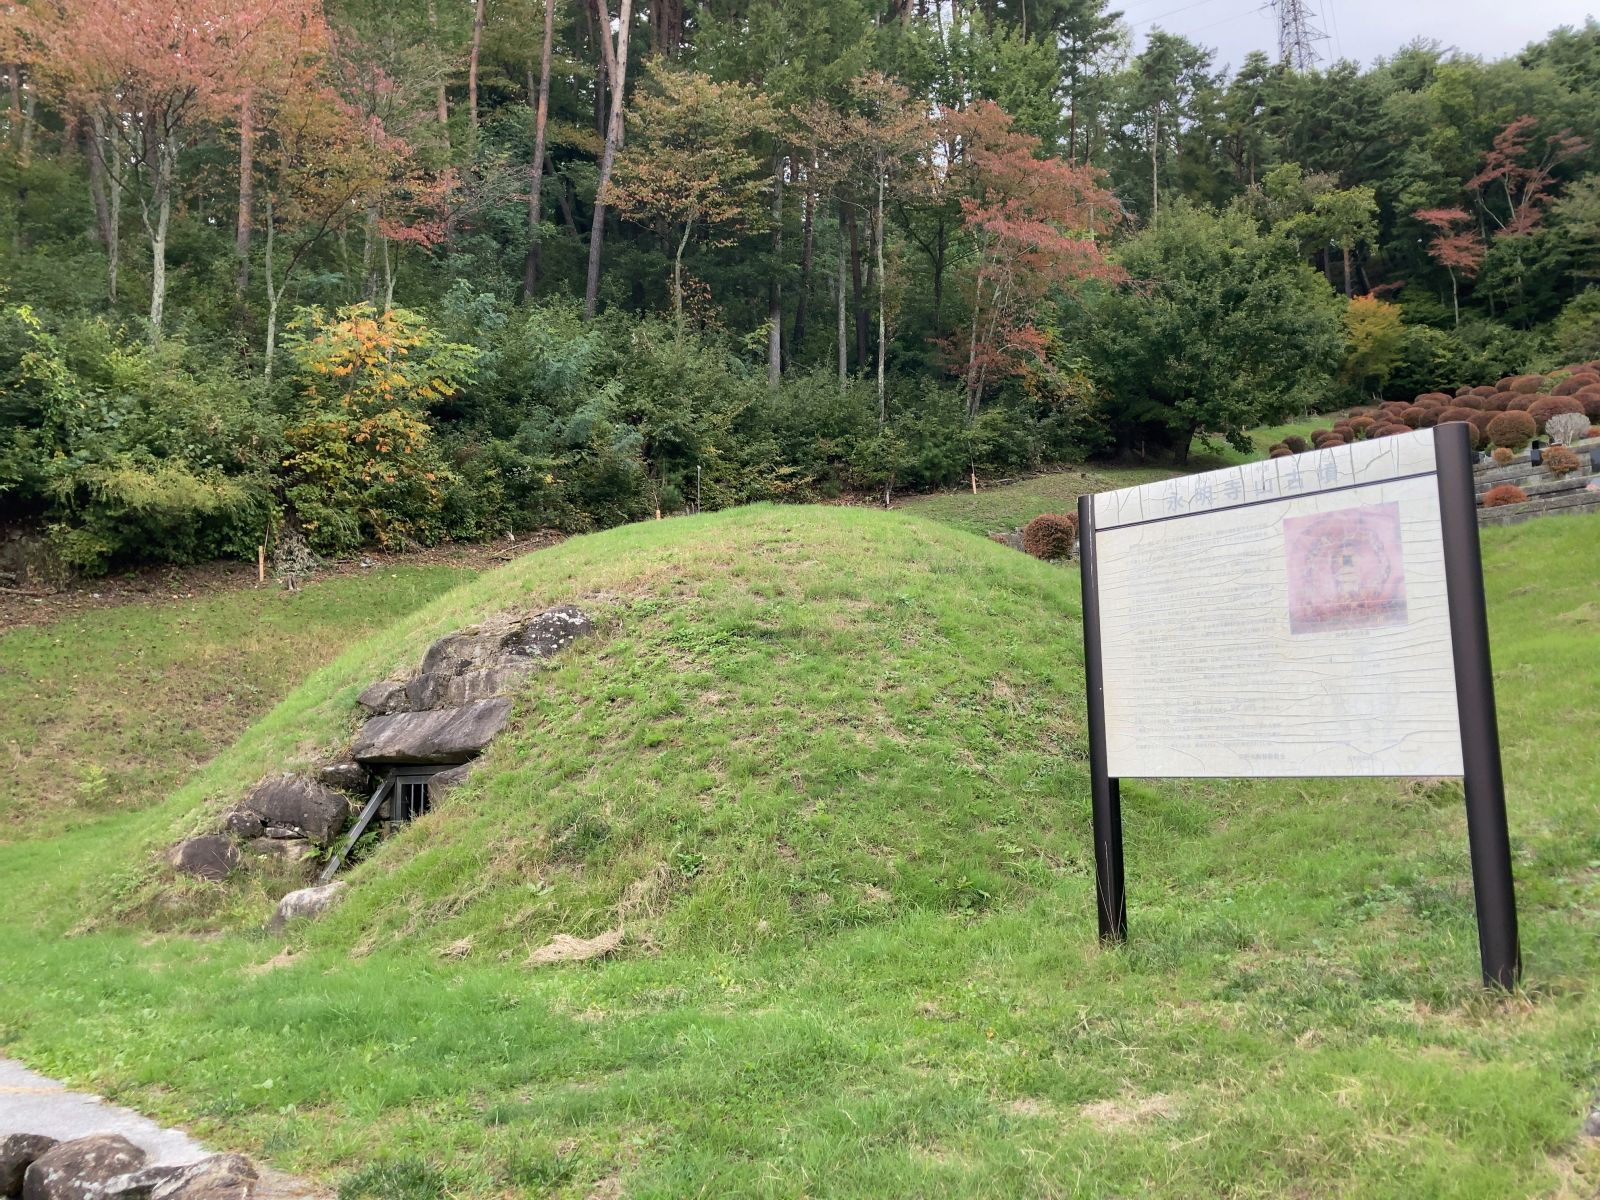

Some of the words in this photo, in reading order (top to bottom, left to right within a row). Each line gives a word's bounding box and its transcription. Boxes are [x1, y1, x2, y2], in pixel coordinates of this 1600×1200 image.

[1167, 462, 1337, 511] 永明寺山古墳
